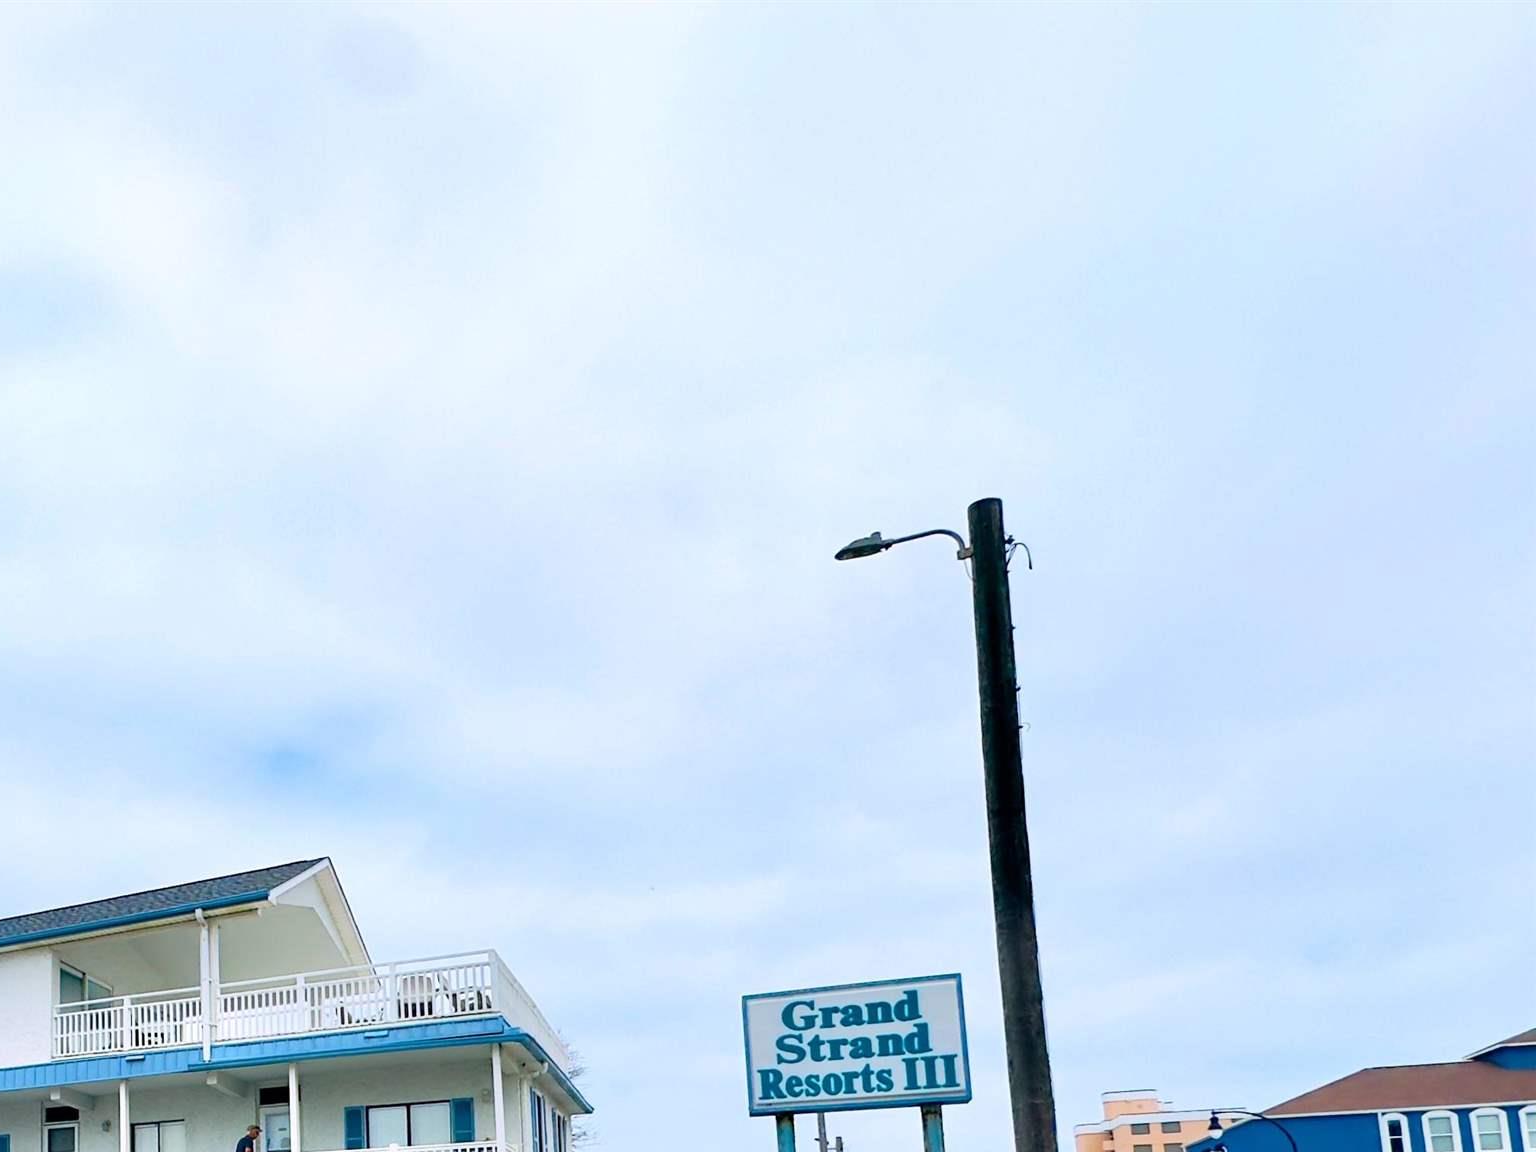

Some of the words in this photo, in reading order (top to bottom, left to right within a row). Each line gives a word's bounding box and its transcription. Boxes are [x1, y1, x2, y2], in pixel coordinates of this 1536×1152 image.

[781, 990, 922, 1030] Grand
[775, 1022, 933, 1065] Strand
[757, 1065, 894, 1099] Resorts
[902, 1054, 961, 1091] III
